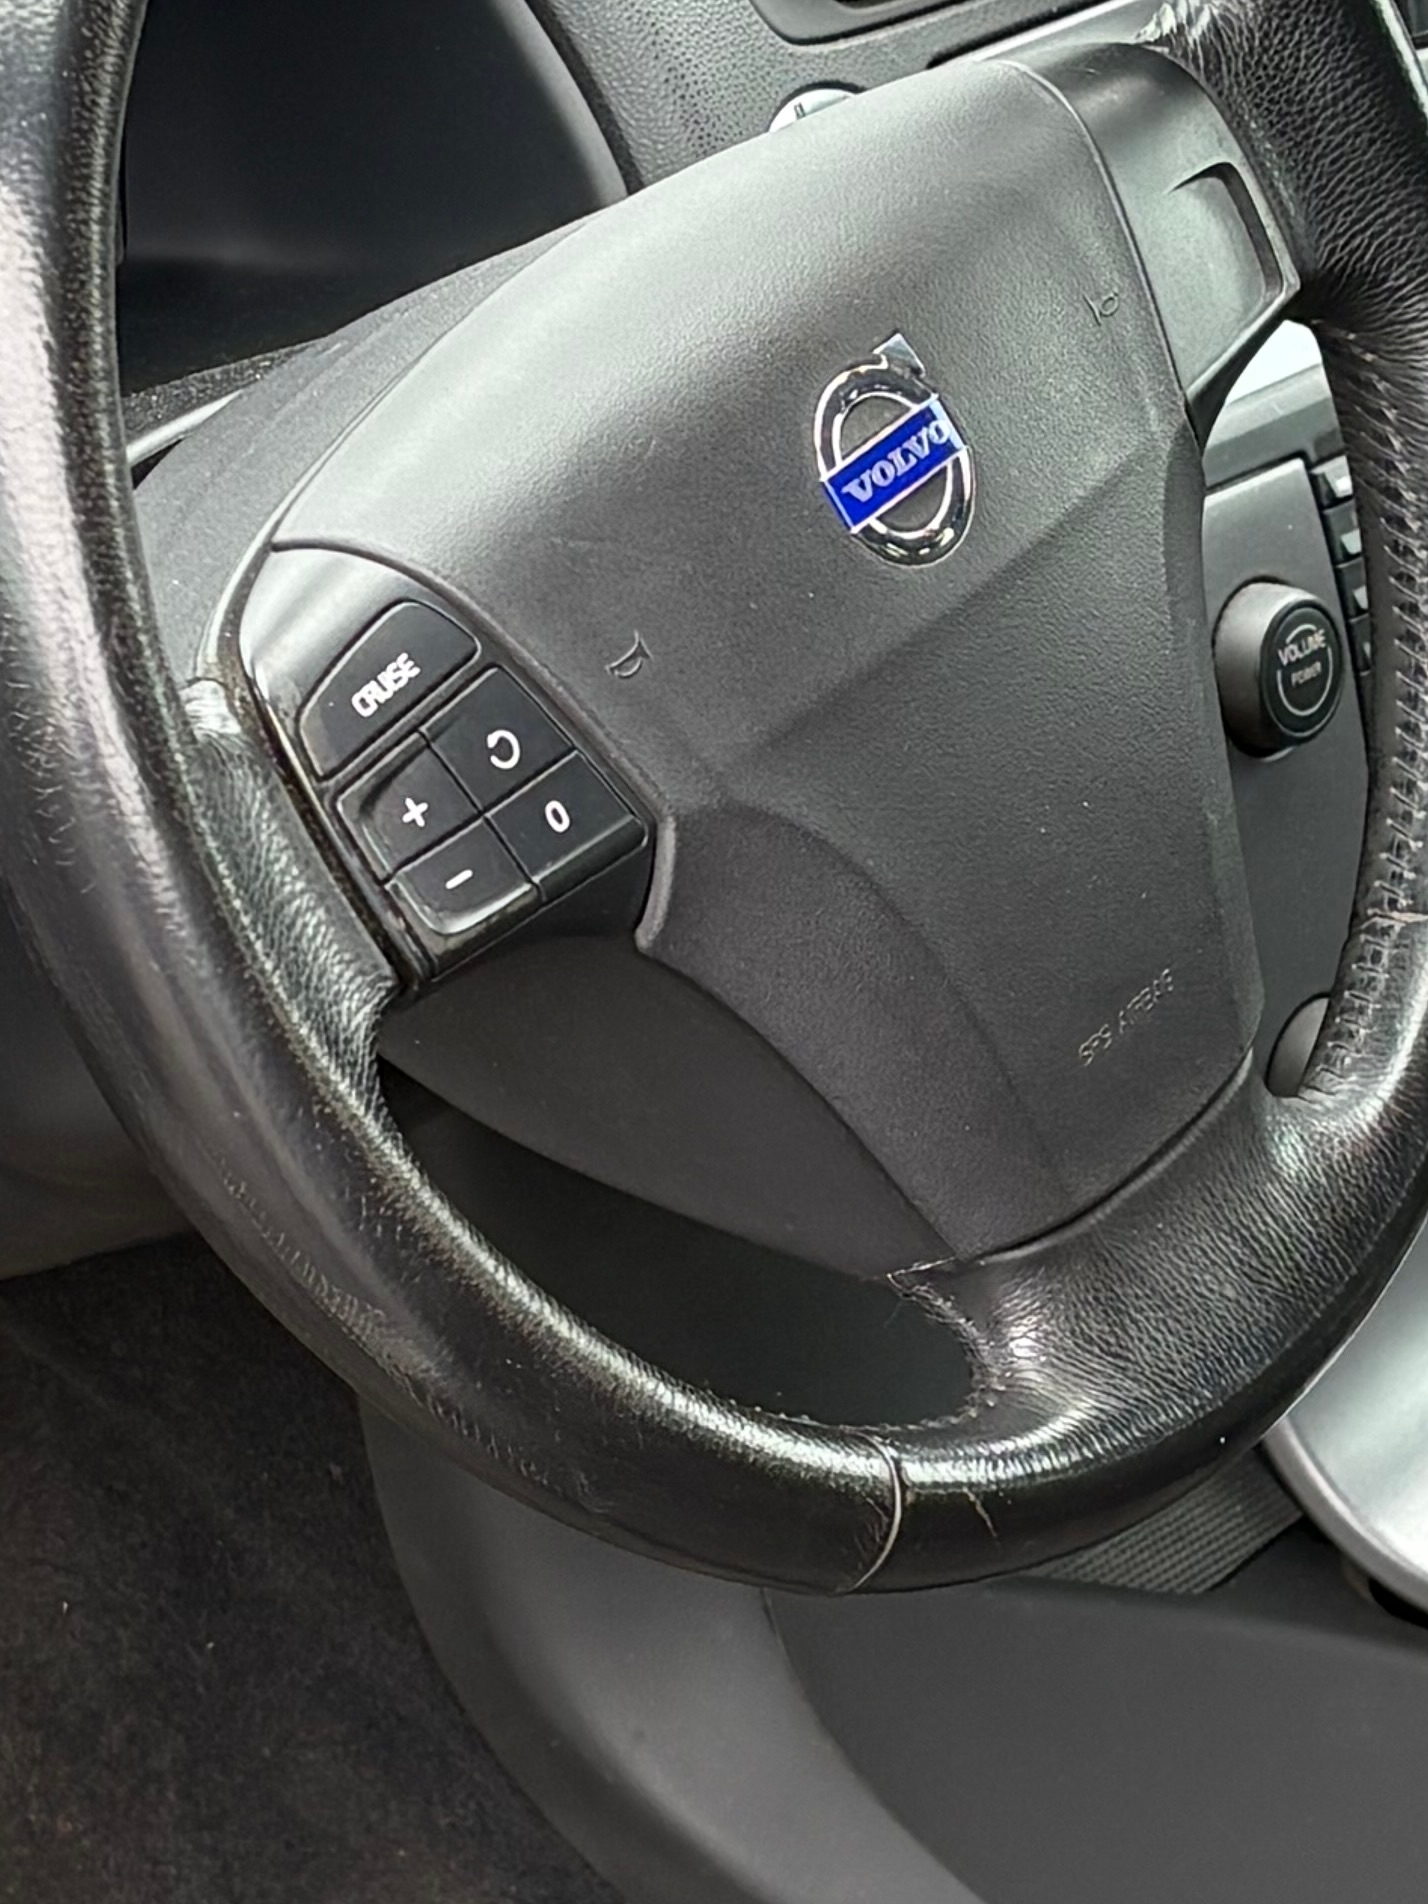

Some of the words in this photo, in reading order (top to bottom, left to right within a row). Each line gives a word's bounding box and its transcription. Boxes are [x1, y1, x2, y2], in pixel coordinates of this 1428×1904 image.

[840, 419, 951, 503] VOLVO
[1278, 628, 1327, 667] VOLUME
[351, 652, 421, 718] CRUISE
[544, 800, 571, 833] 0
